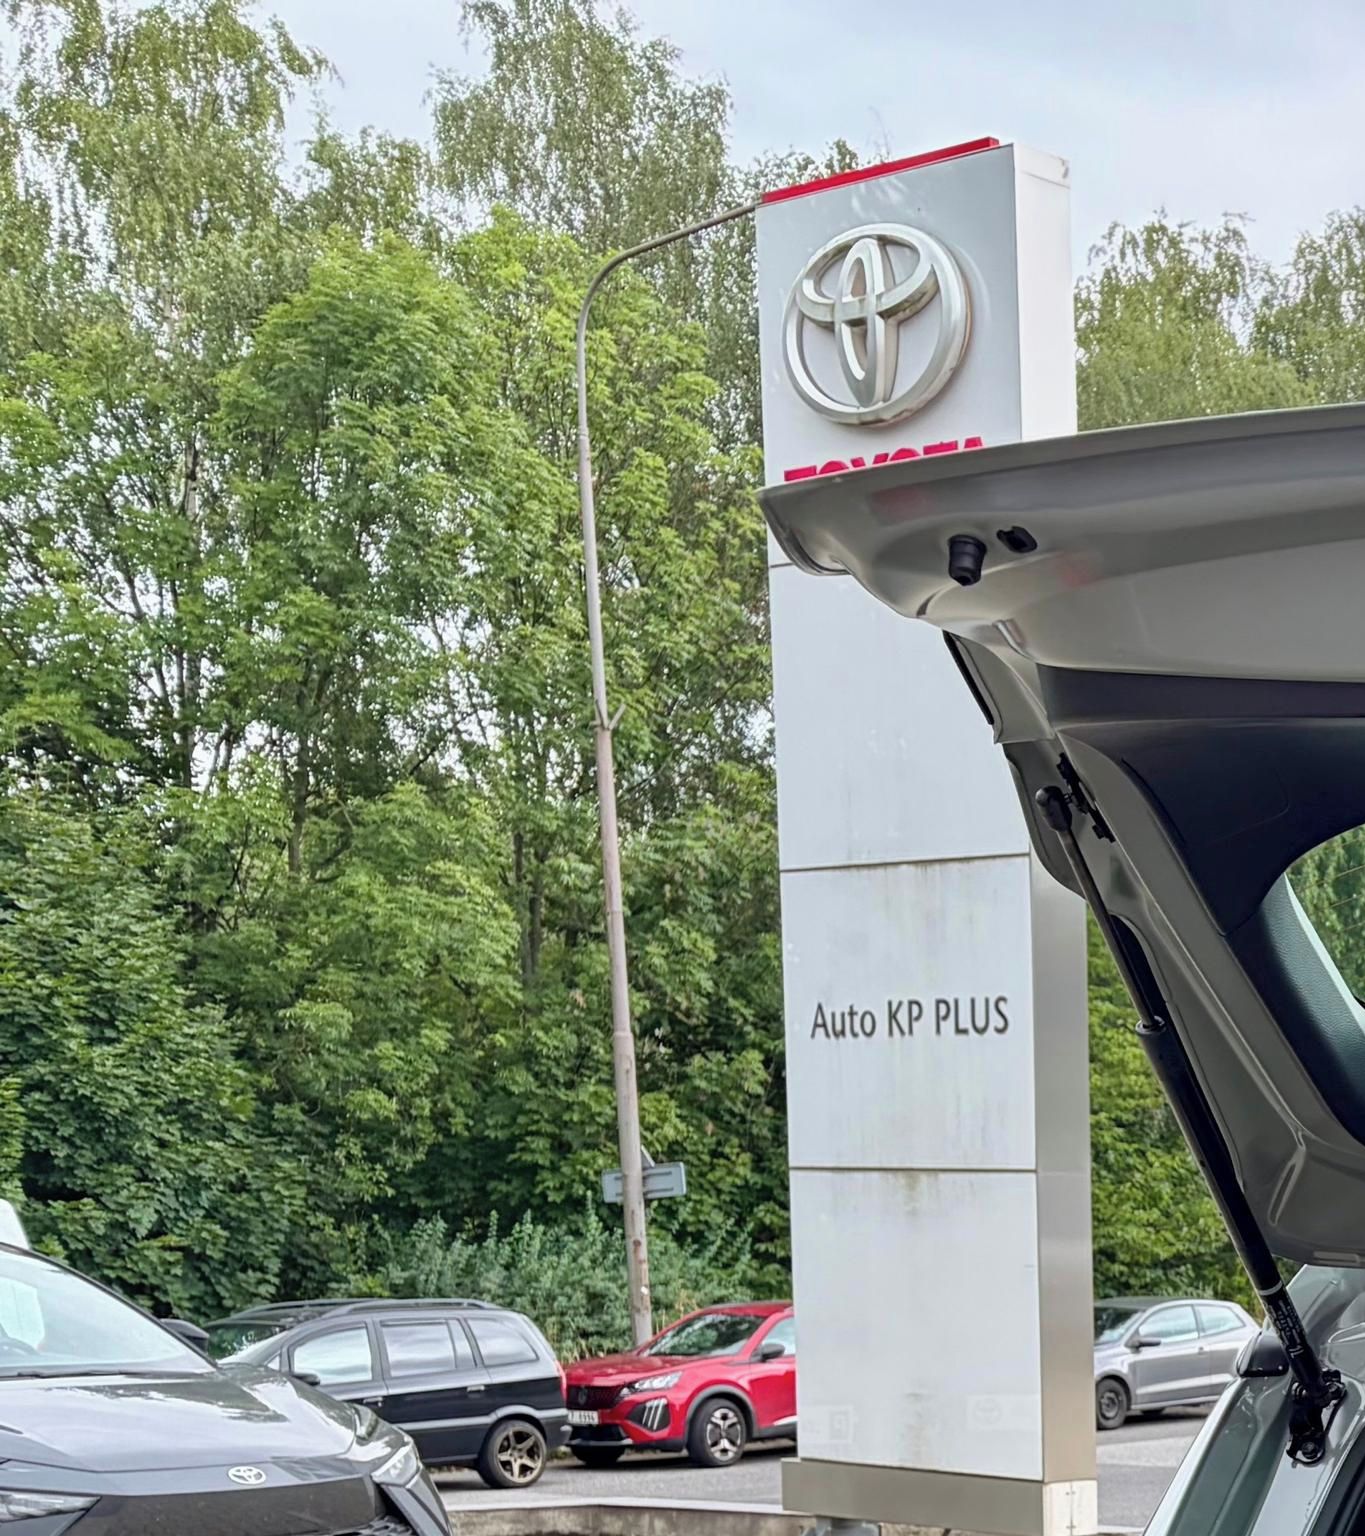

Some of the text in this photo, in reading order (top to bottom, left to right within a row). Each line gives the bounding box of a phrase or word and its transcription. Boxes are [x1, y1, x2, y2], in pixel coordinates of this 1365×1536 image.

[810, 996, 1009, 1039] Auto KP PLUS
